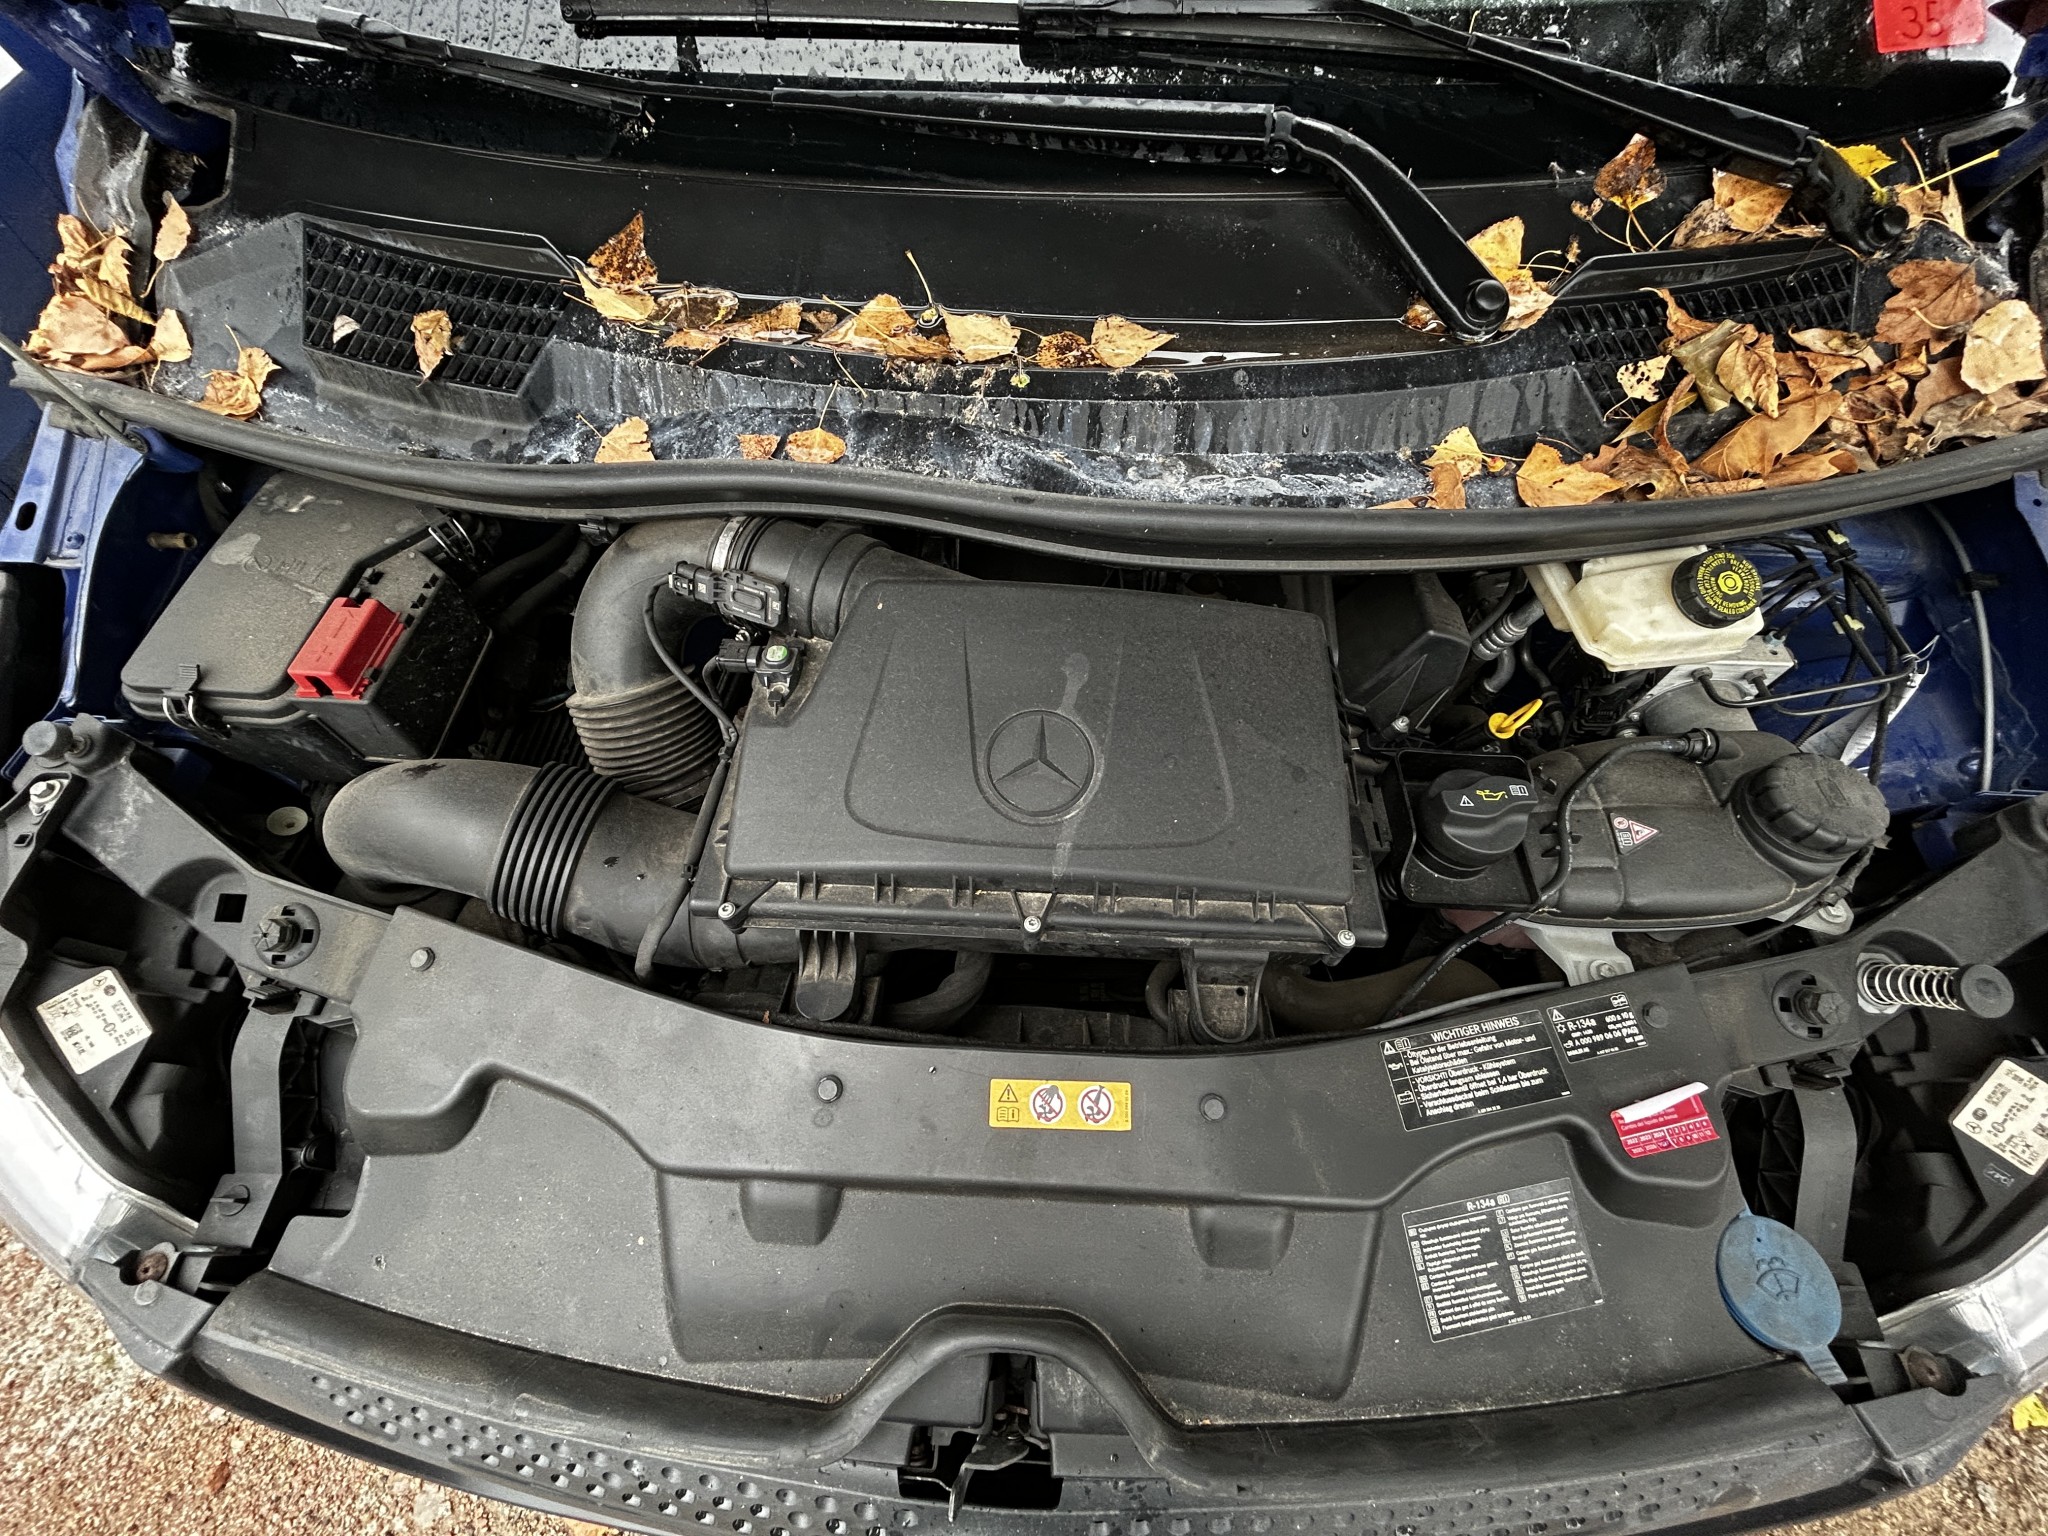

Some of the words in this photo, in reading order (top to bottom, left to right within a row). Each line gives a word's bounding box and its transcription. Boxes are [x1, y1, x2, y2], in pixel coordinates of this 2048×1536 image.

[1902, 1, 1944, 38] 35
[1567, 1018, 1597, 1031] R-134a
[1605, 1015, 1616, 1023] 600
[1431, 1024, 1482, 1042] WICHTIGER
[1482, 1016, 1520, 1032] HINWEIS
[1447, 1035, 1497, 1050] Betriebsanleitung
[1580, 1037, 1592, 1045] 000
[1420, 1054, 1443, 1064] Ölstand
[1473, 1044, 1493, 1053] Gefahr
[1504, 1038, 1524, 1046] Motor-
[1411, 1058, 1468, 1074] Katalysatorschäden
[1448, 1065, 1479, 1078] Überdruck
[1482, 1059, 1516, 1070] Kühlsystem
[1418, 1080, 1449, 1092] Überdruck
[1449, 1076, 1474, 1086] langsam
[1474, 1070, 1500, 1080] ablassen
[1420, 1084, 1469, 1100] Sicherheitsventil
[1469, 1081, 1487, 1090] öffnet
[1497, 1076, 1507, 1084] 1,4
[1517, 1067, 1549, 1079] Überdruck
[1422, 1092, 1474, 1108] Verschlussdeckel
[1473, 1089, 1490, 1097] beim
[1489, 1083, 1521, 1094] Schliessen
[1426, 1105, 1454, 1116] Anschlag
[1453, 1101, 1475, 1110] drehen
[1466, 1198, 1496, 1211] R-134a
